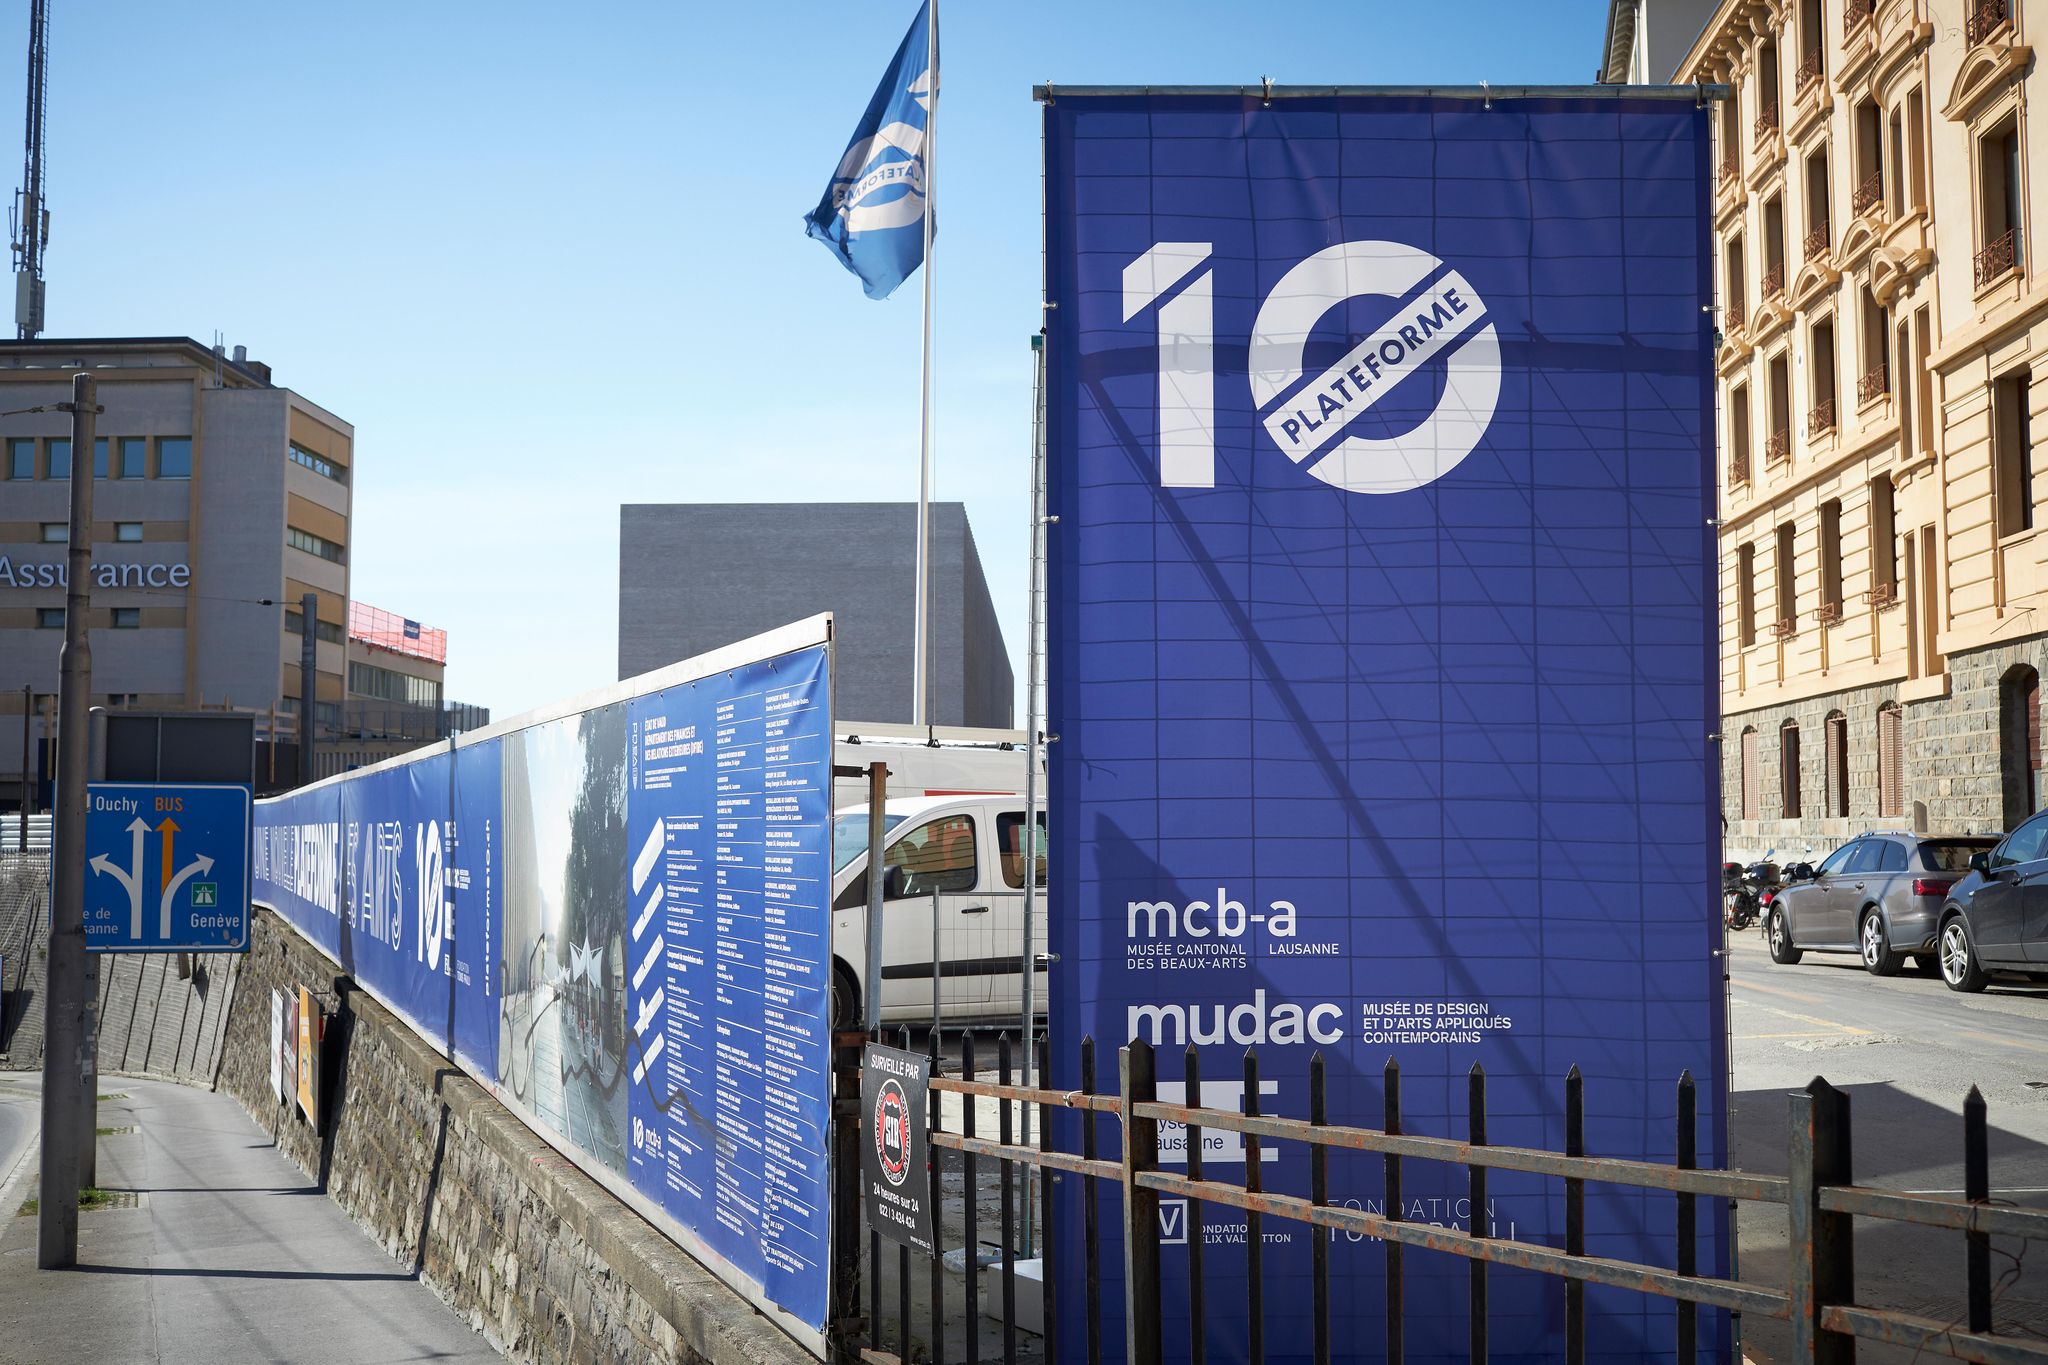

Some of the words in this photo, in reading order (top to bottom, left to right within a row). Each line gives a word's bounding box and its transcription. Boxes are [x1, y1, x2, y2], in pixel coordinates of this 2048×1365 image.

[1122, 239, 1502, 495] 10
[1280, 286, 1470, 445] PLATEFORME
[96, 796, 138, 815] Ouchy
[155, 797, 183, 811] BUS
[361, 821, 402, 951] ARTS
[416, 819, 443, 971] 10
[190, 912, 239, 928] Genève
[1127, 887, 1297, 938] mcb-a
[1127, 941, 1172, 956] MUSÉE
[1177, 943, 1246, 956] CANTONAL
[1269, 943, 1340, 955] LAUSANNE
[1127, 957, 1154, 970] DES
[1160, 957, 1247, 969] BEAUX-ARTS
[1127, 989, 1344, 1046] mudac
[1363, 1001, 1411, 1016] MUSÉE
[1414, 1003, 1433, 1015] DE
[1437, 1003, 1489, 1015] DESIGN
[1363, 1017, 1380, 1030] ET
[1435, 1015, 1512, 1029] APPLIQUÉS
[1363, 1031, 1481, 1044] CONTEMPORAINS
[871, 1053, 905, 1076] SURVEILLÉ
[905, 1063, 920, 1080] PAR
[885, 1115, 900, 1150] SIR
[873, 1182, 881, 1197] 24
[881, 1185, 901, 1205] heures
[901, 1197, 911, 1210] sur
[912, 1199, 920, 1214] 24
[906, 1216, 915, 1230] 424
